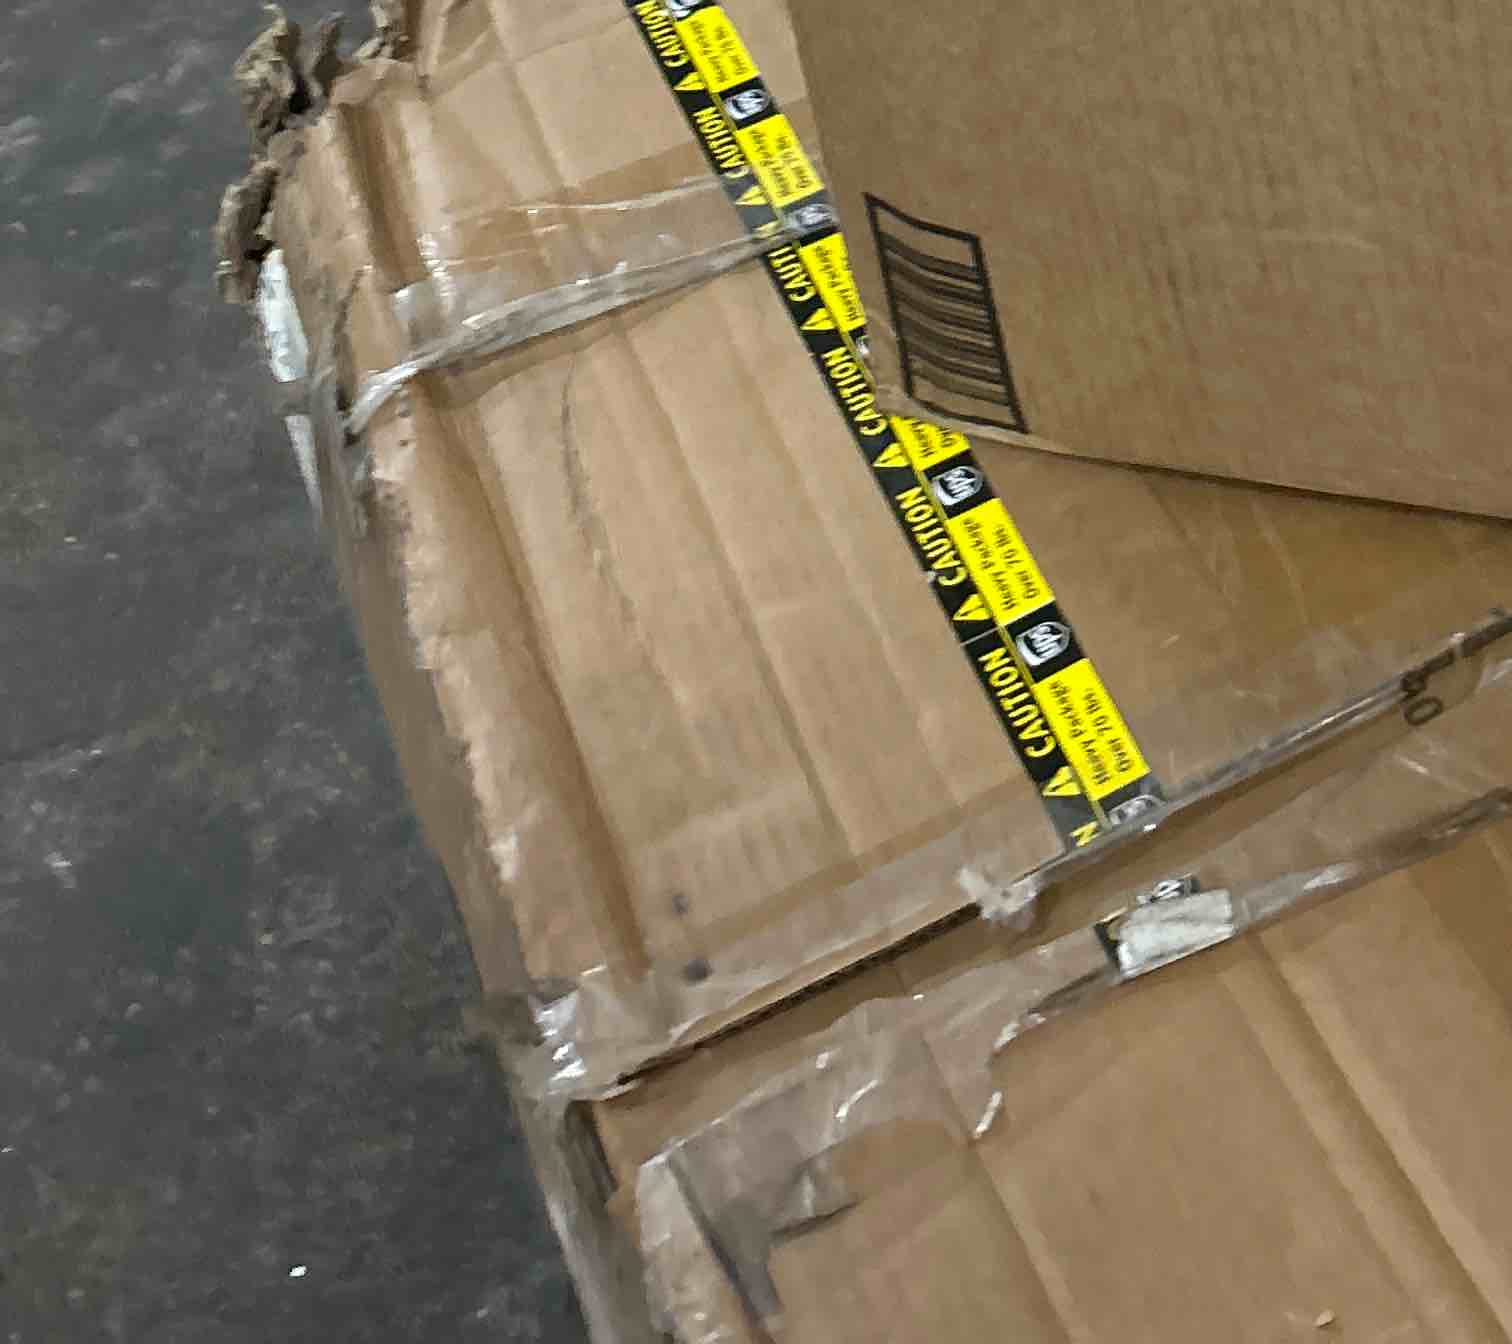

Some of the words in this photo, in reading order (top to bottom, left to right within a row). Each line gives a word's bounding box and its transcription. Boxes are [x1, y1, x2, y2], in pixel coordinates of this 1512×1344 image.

[694, 105, 750, 180] CAUTION
[822, 346, 888, 438] CAUTION
[895, 485, 967, 588] CAUTION
[977, 646, 1058, 759] CAUTION
